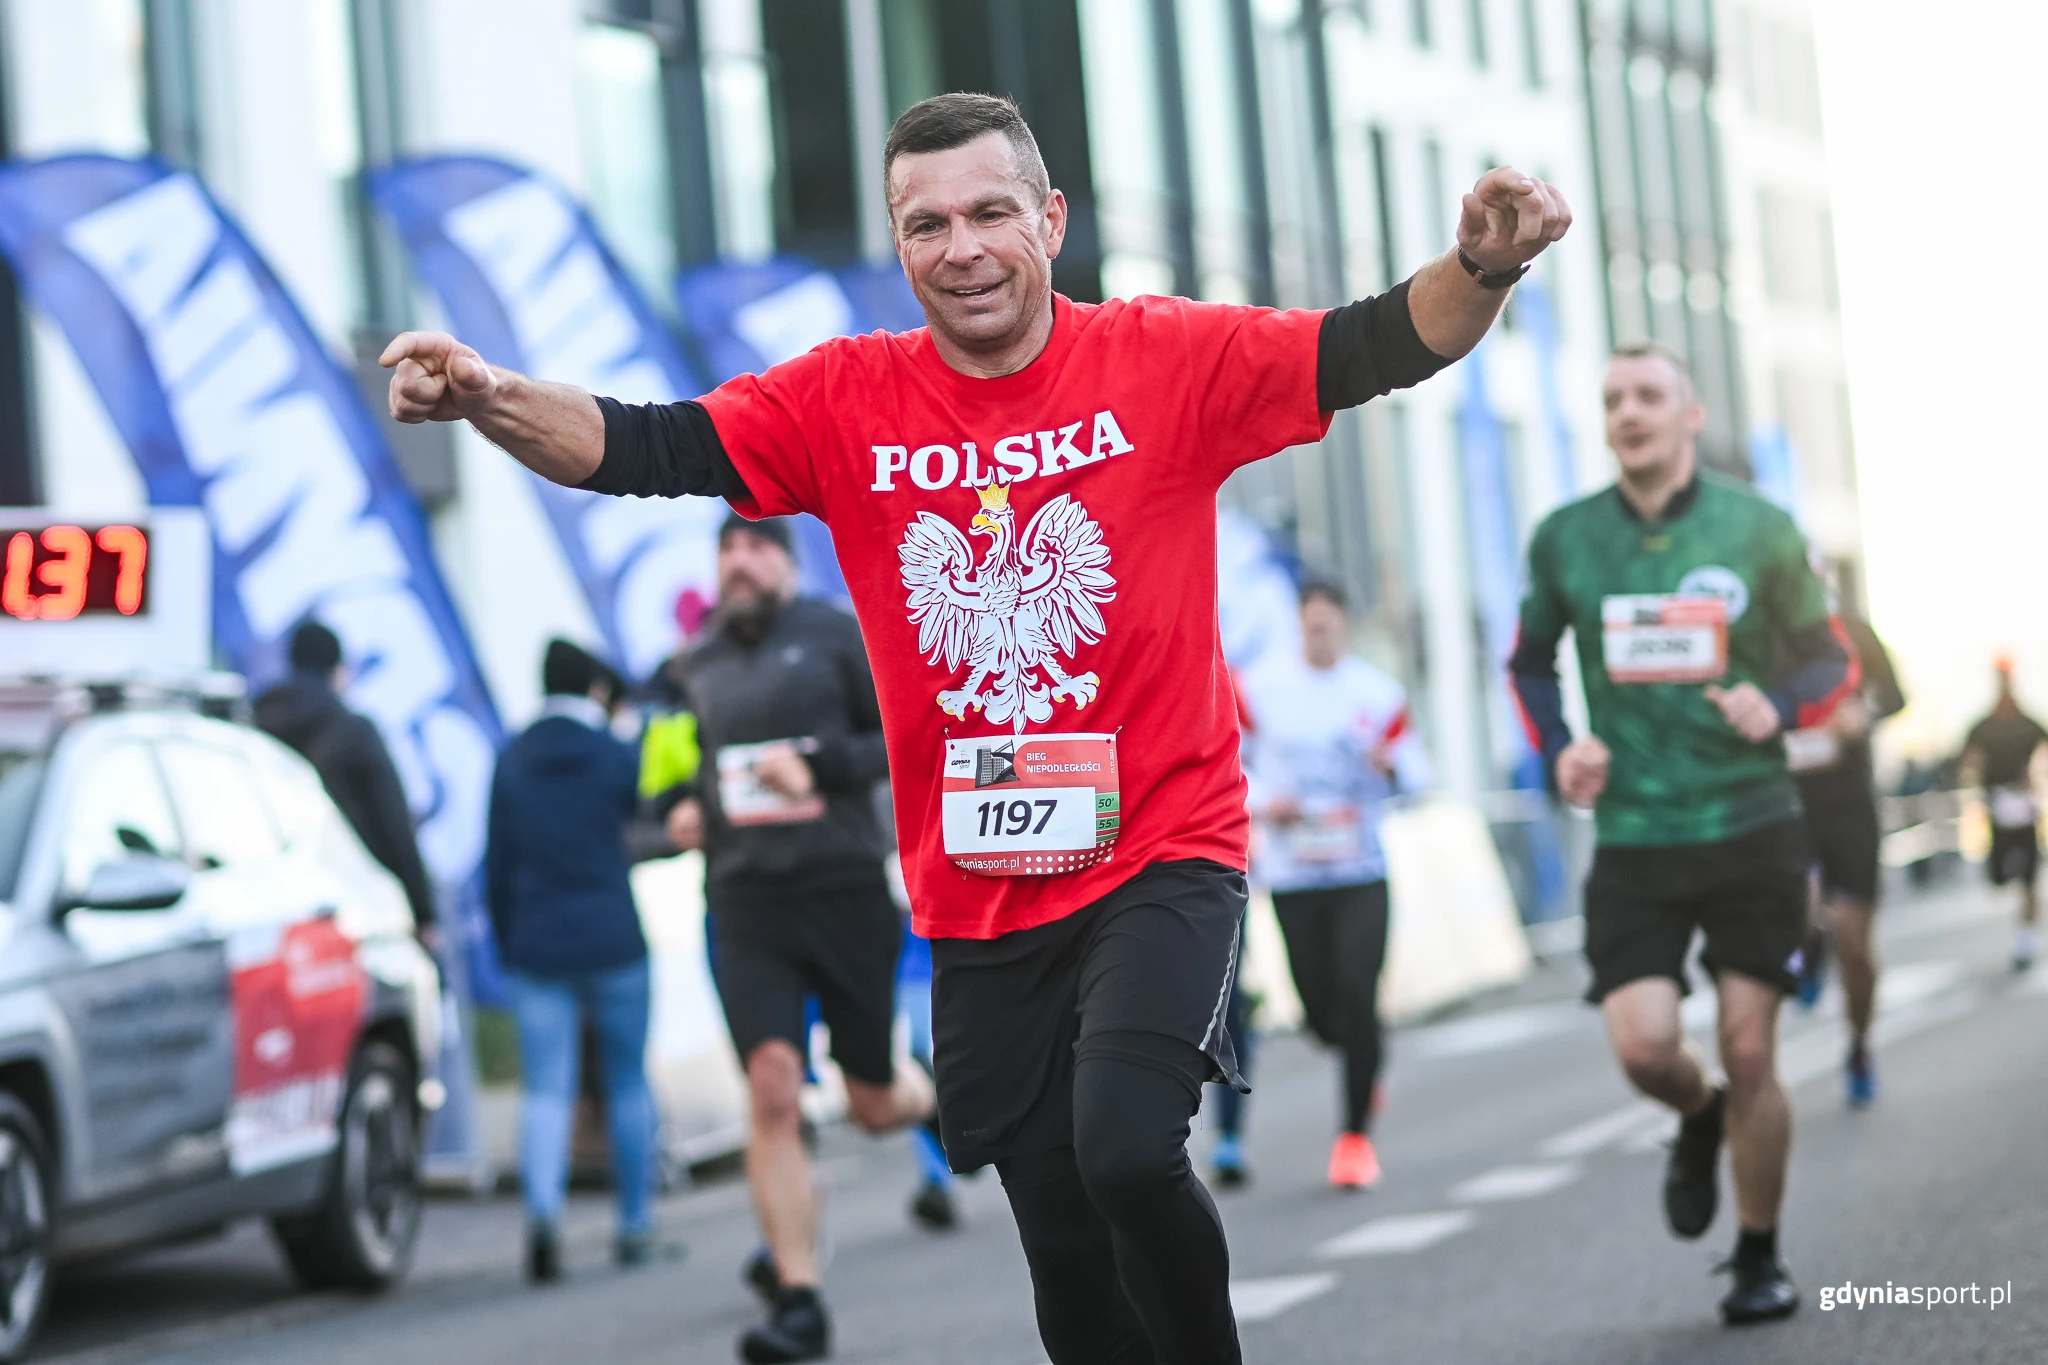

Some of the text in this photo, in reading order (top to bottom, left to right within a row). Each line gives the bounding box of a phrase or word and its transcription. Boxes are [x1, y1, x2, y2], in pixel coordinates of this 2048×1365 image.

[871, 410, 1135, 491] POLSKA
[1026, 752, 1046, 761] BIEG
[1026, 761, 1100, 773] NIEPODLEGŁOŚCI
[977, 800, 1057, 836] 1197
